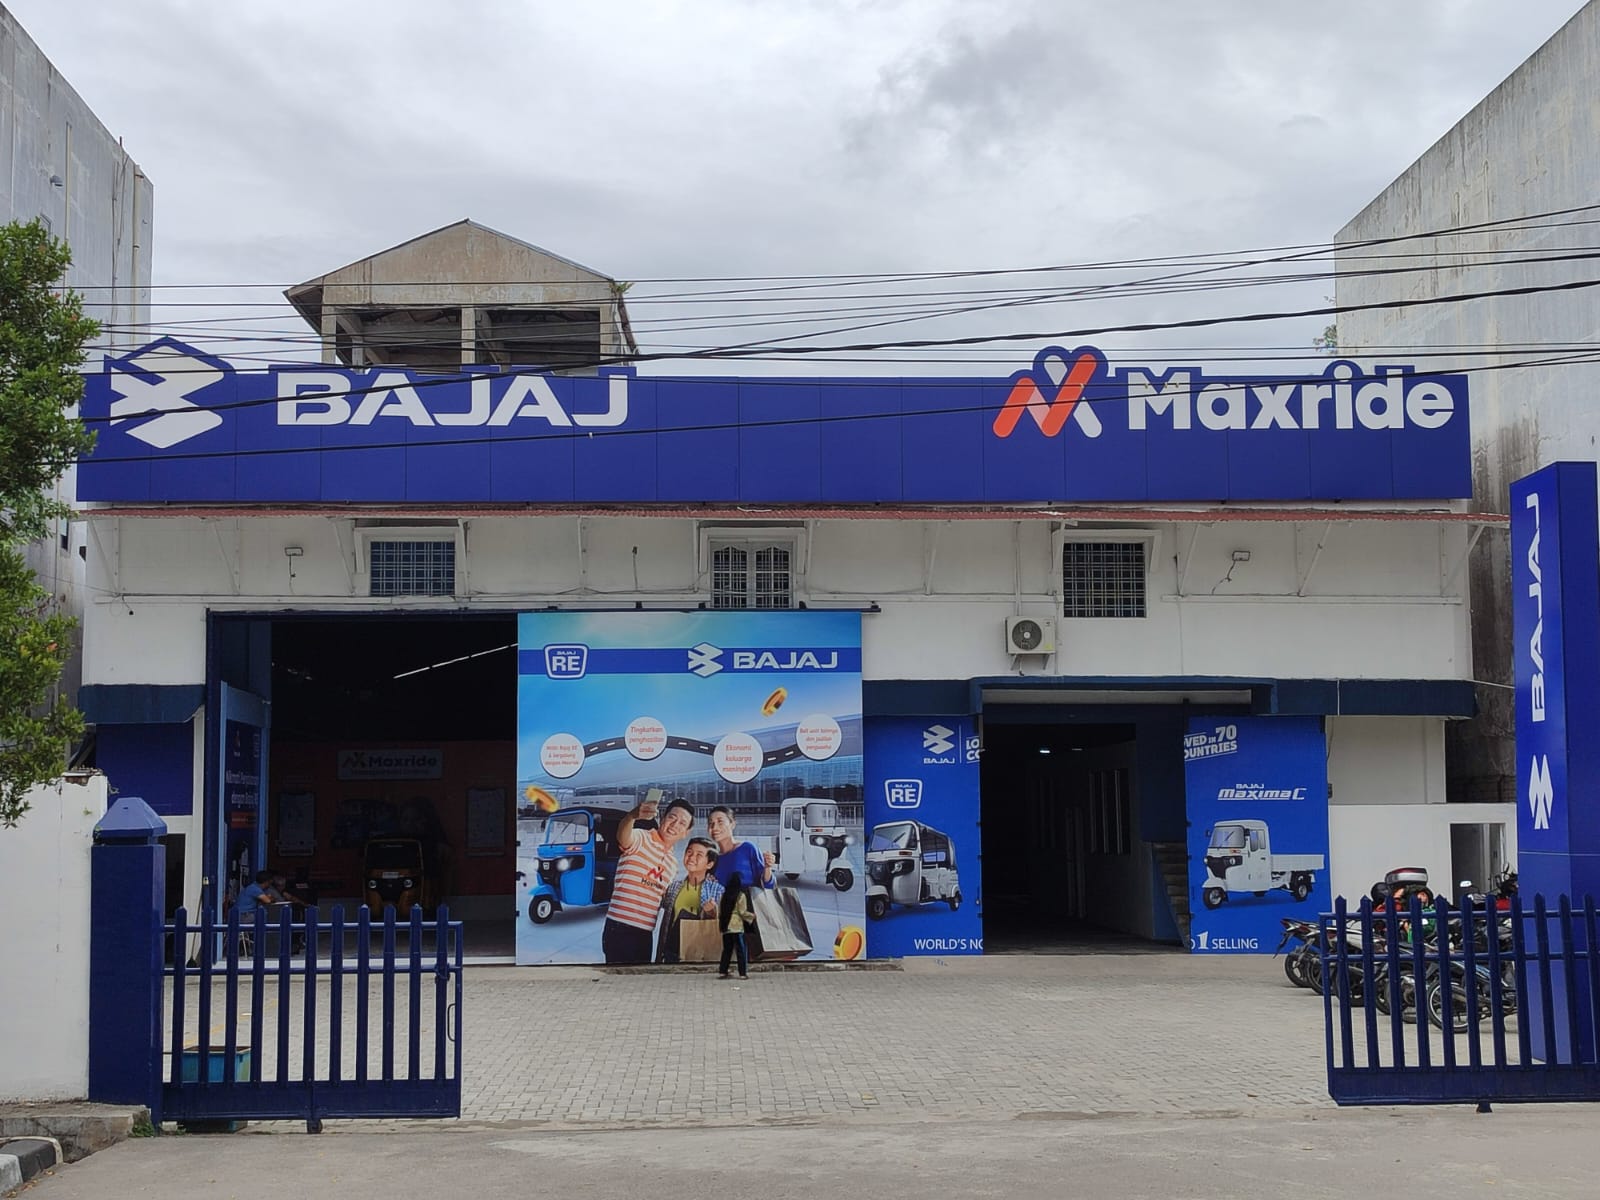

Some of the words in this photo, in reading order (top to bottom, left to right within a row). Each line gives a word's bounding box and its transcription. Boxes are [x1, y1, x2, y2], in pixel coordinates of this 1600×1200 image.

[277, 372, 628, 427] BAJAJ
[1127, 361, 1455, 430] Maxride
[1526, 492, 1545, 722] BAJAJ
[552, 655, 580, 672] RE
[733, 651, 838, 670] BAJAJ
[630, 726, 663, 734] Tingkatkan
[1183, 735, 1207, 748] VED
[1216, 725, 1237, 742] 70
[368, 755, 437, 768] Maxride
[725, 755, 752, 763] keluarga
[722, 765, 755, 774] meningkat
[891, 788, 916, 803] RE
[913, 938, 967, 950] WORLD'S
[1211, 938, 1258, 950] SELLING
